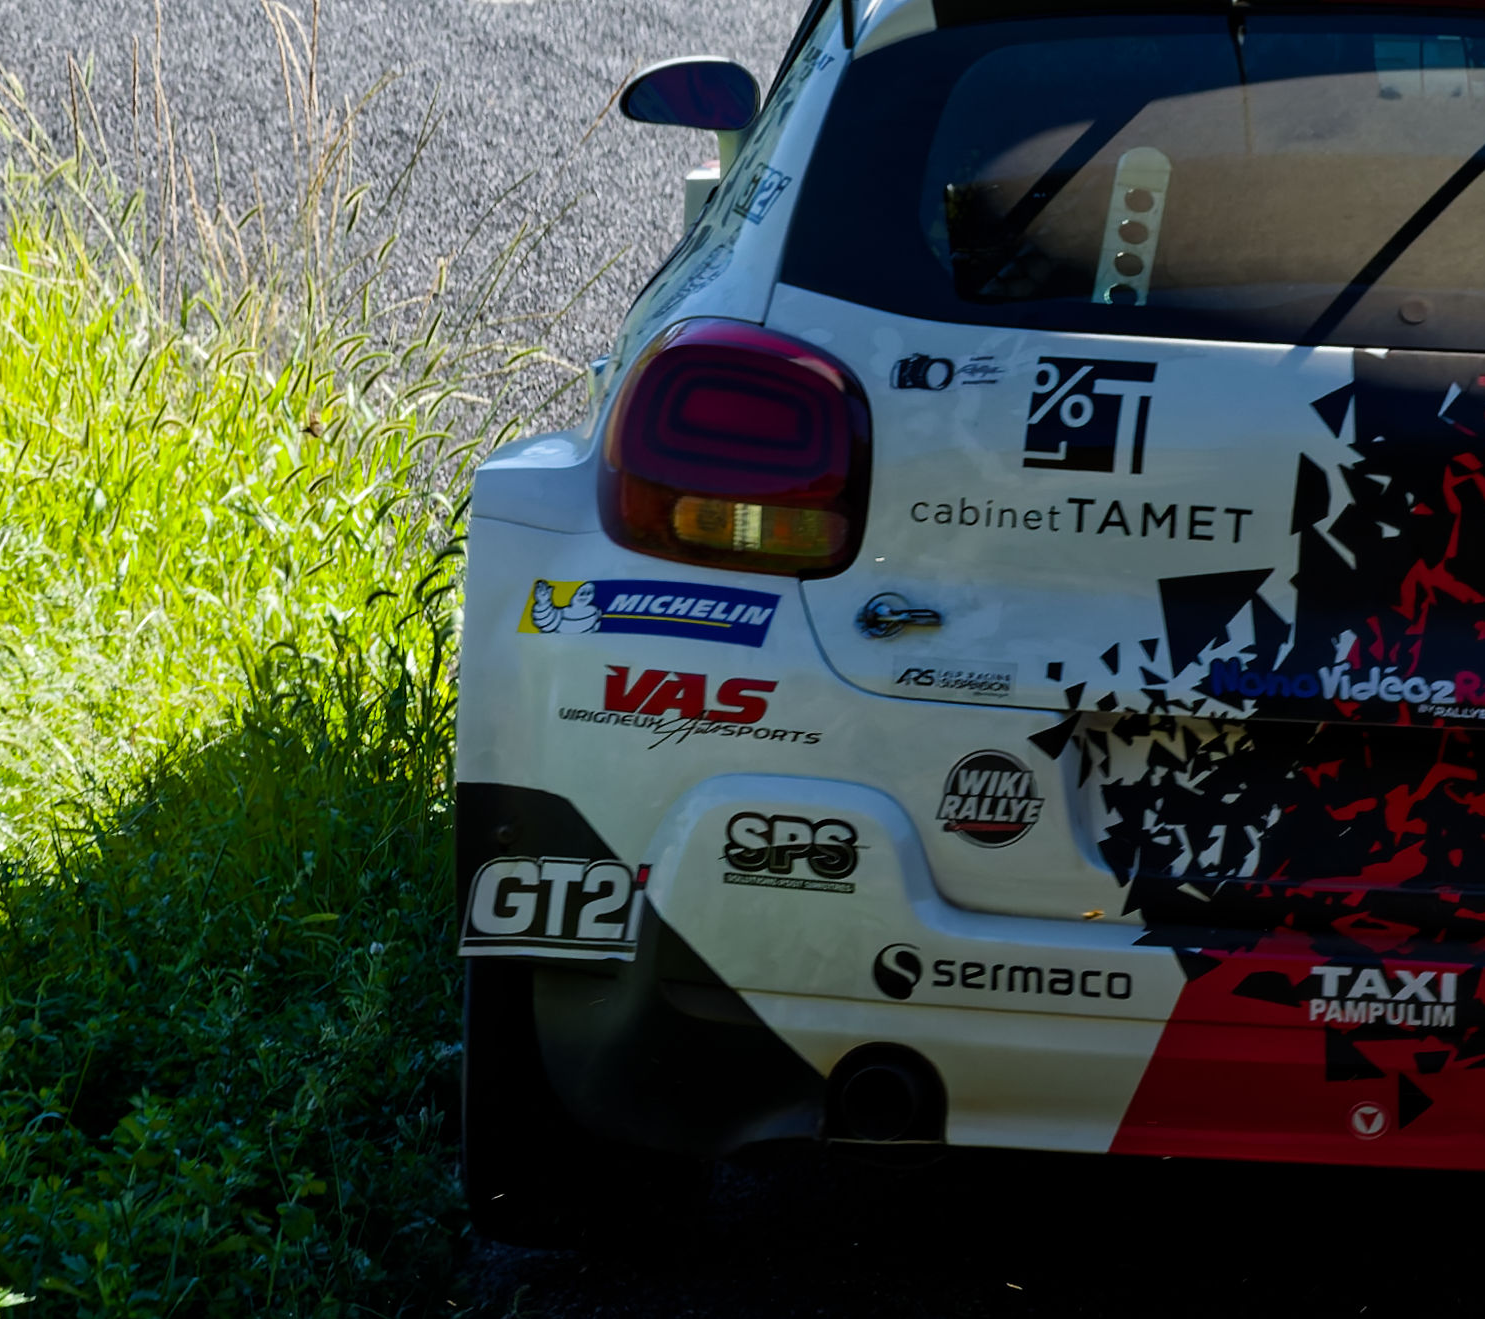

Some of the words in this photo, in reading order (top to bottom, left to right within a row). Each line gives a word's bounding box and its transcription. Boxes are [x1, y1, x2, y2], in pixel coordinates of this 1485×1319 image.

[606, 592, 776, 627] MICHELIN
[603, 664, 780, 724] VAS
[958, 768, 1033, 798] WIKI
[938, 794, 1043, 824] RALLYE
[724, 811, 859, 880] SPS
[471, 860, 650, 942] GT2i
[932, 959, 1132, 1000] sermaco
[1310, 965, 1458, 1003] TAXI
[1309, 998, 1456, 1027] PAMPULIM
